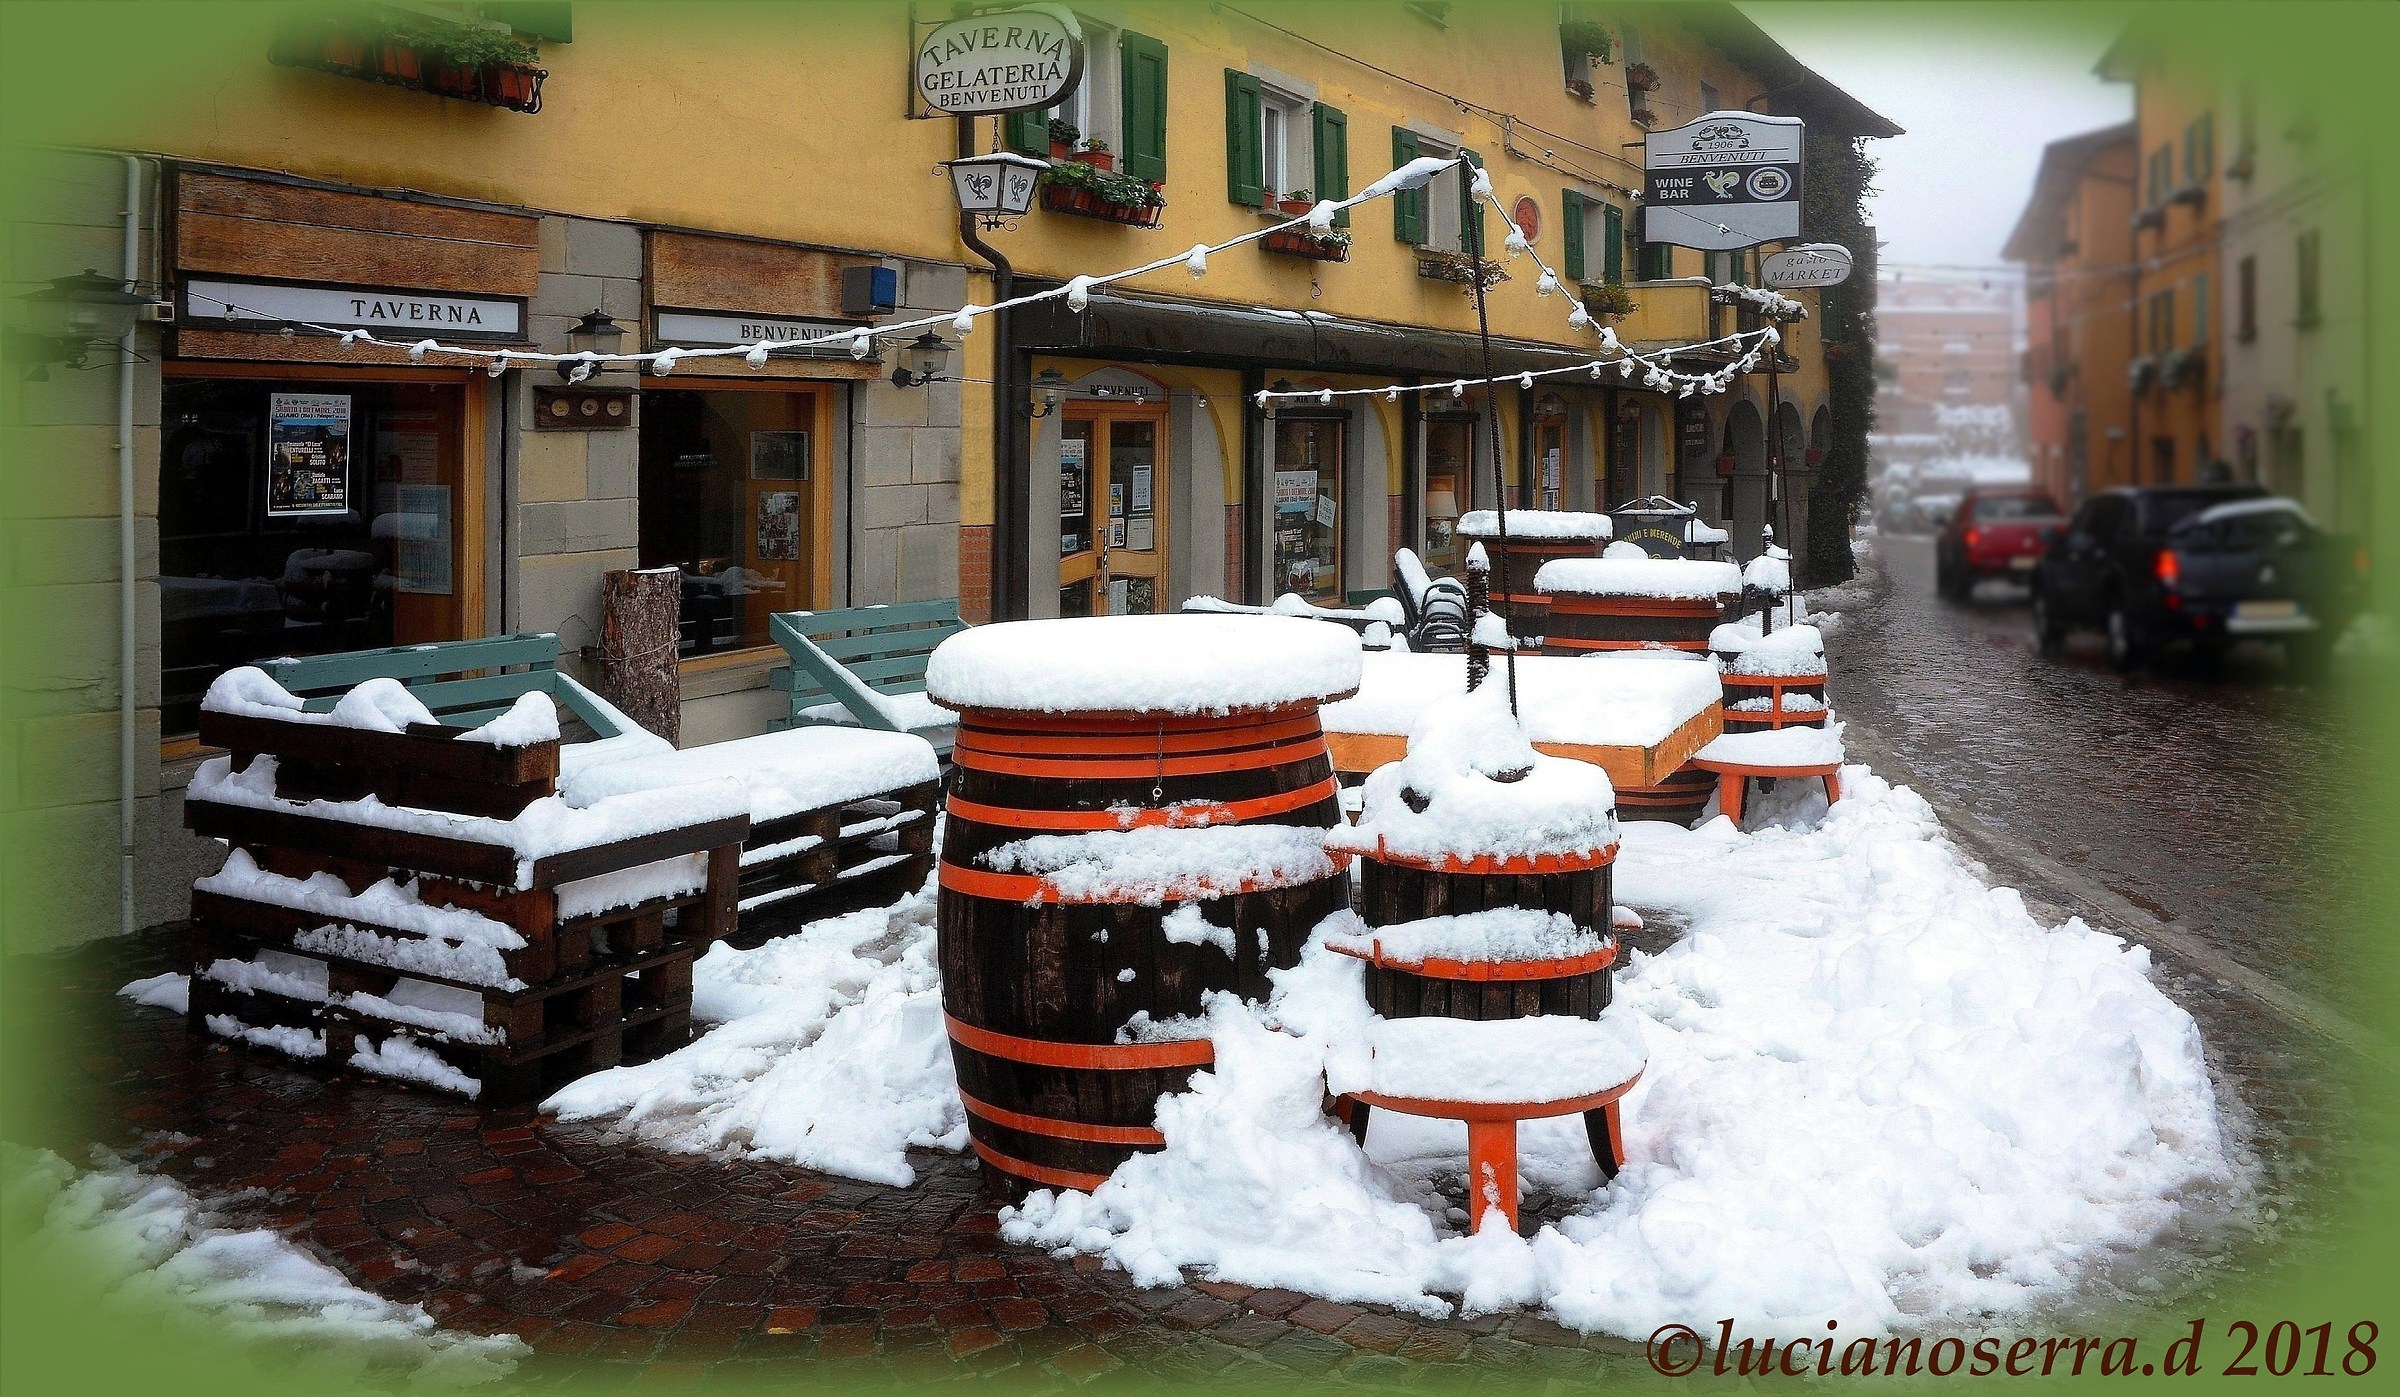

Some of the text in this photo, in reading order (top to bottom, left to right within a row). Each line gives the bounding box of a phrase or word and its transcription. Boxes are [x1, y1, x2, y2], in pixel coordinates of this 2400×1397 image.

[923, 26, 1065, 67] TAVERNA
[923, 61, 1063, 91] GELATERIA
[940, 84, 1047, 107] BENVENUTI
[1708, 141, 1733, 149] 1906
[1680, 151, 1766, 164] BENVENUTI
[1655, 177, 1693, 188] WINE
[1660, 189, 1689, 199] BAR
[1771, 267, 1844, 281] MARKET
[350, 299, 482, 324] TAVERNA
[740, 324, 844, 341] BENVENUT
